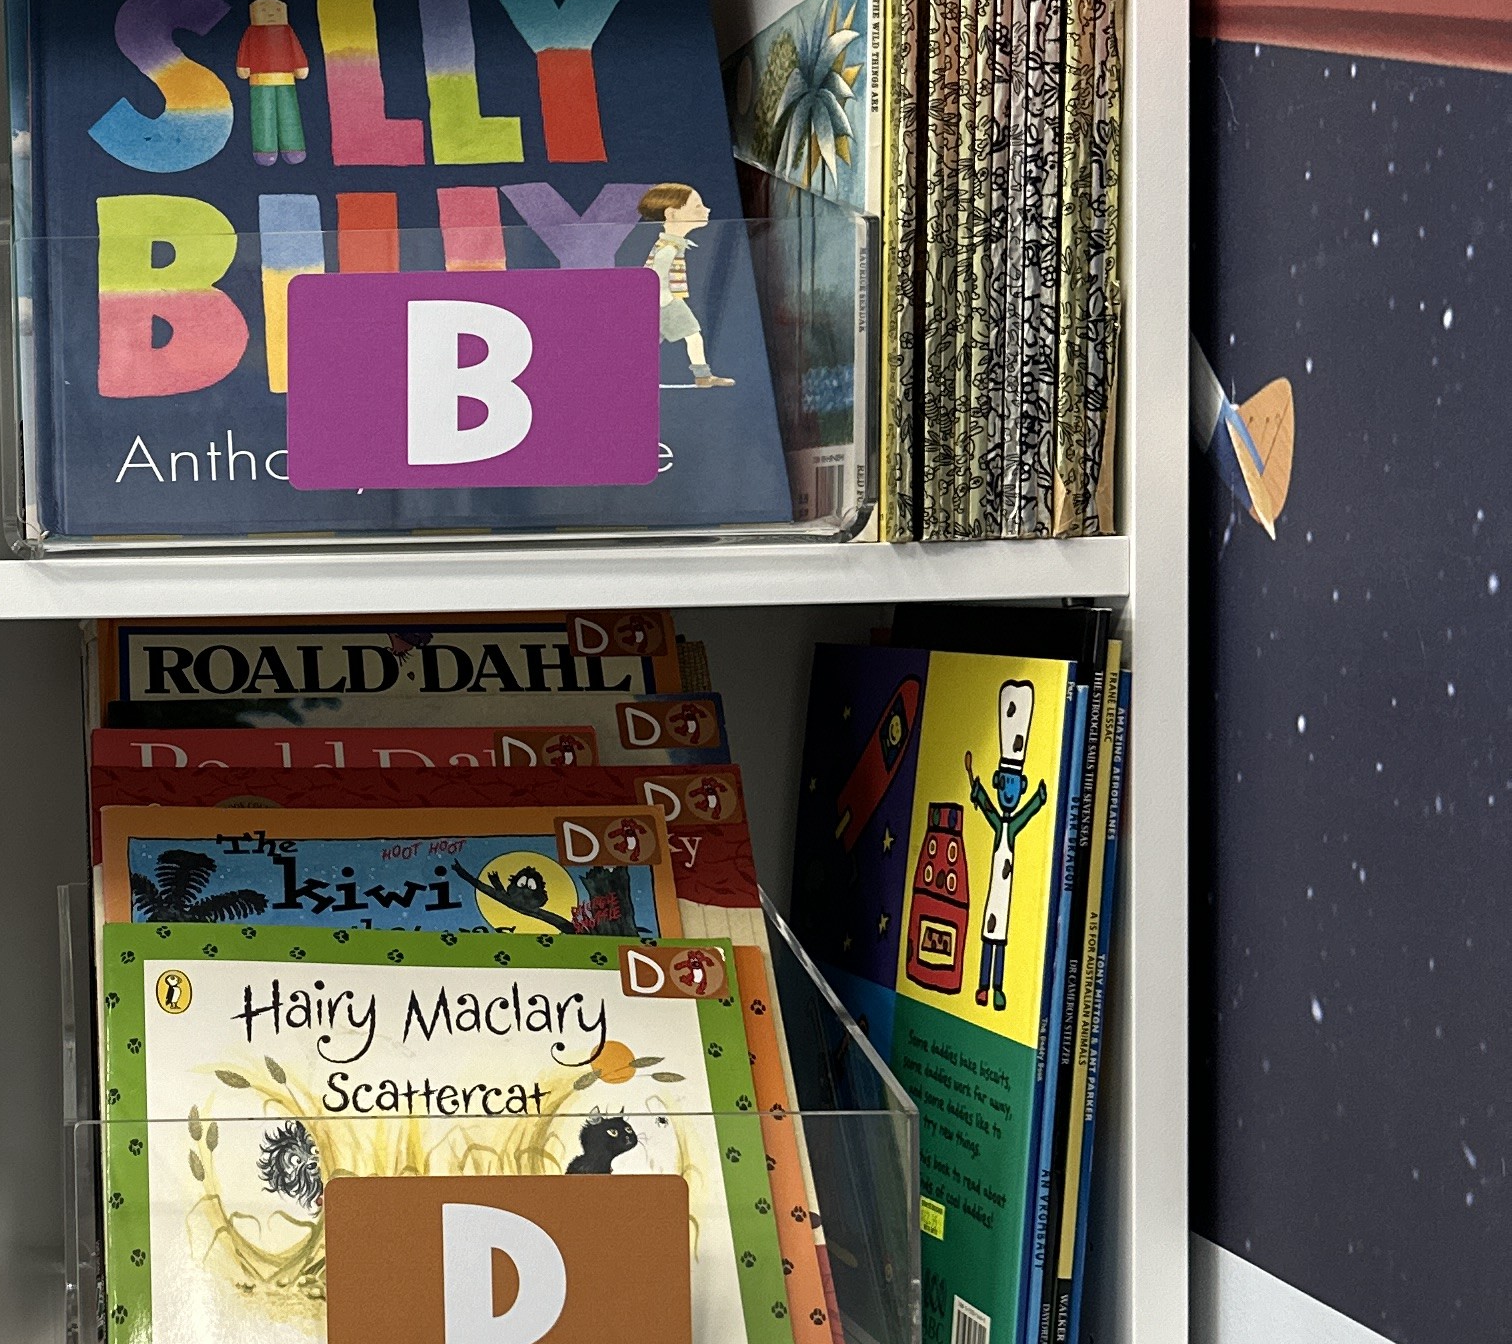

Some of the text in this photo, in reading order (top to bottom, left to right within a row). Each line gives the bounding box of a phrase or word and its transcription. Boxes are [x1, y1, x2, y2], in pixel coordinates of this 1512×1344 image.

[872, 22, 880, 49] WILD
[871, 52, 879, 88] THINGS
[871, 92, 879, 112] ARE
[408, 300, 533, 466] B
[575, 619, 608, 654] D
[143, 643, 632, 696] ROALD DAHL
[626, 706, 661, 747] D
[1106, 707, 1125, 840] AMAZING AEROPLANES
[214, 829, 299, 855] The
[562, 822, 600, 862] D
[272, 856, 463, 912] kiwi
[627, 951, 665, 995] D
[232, 978, 608, 1067] Hairy Maclary
[322, 1071, 552, 1115] Scattercat
